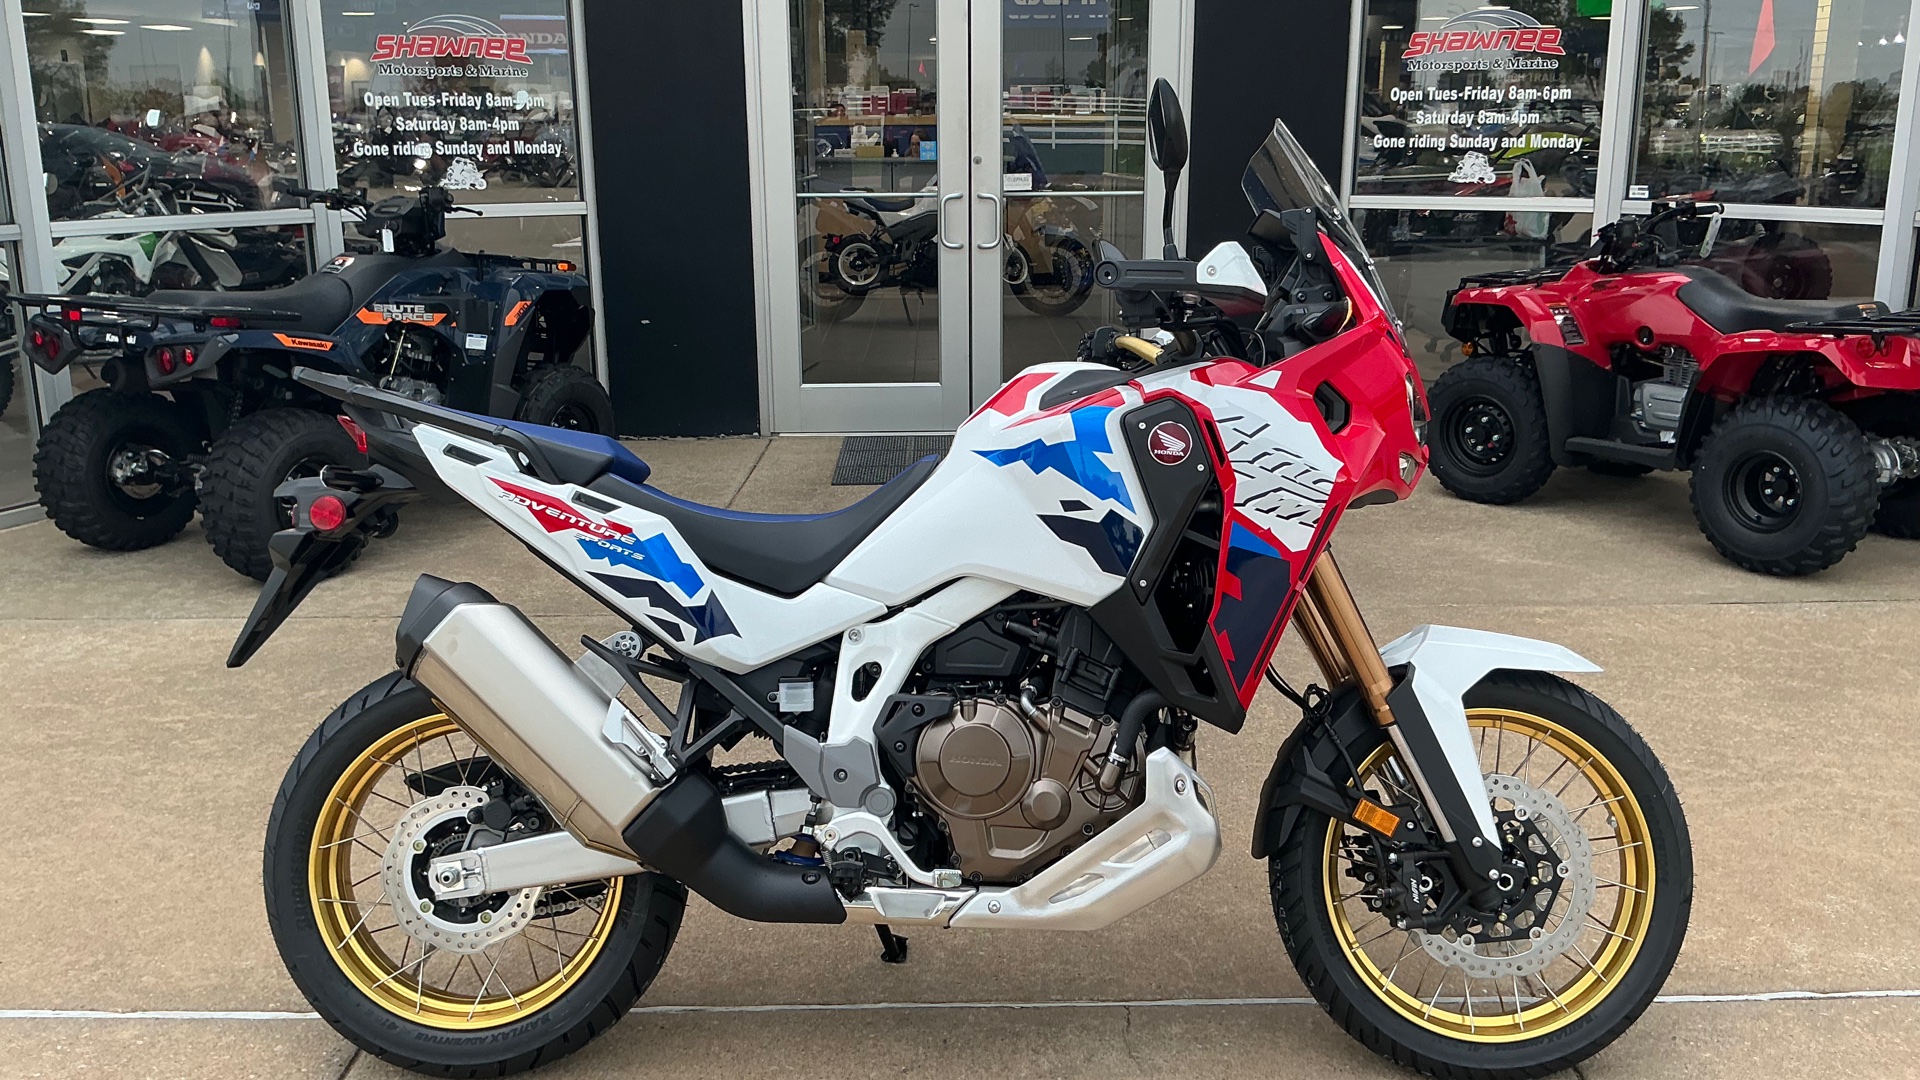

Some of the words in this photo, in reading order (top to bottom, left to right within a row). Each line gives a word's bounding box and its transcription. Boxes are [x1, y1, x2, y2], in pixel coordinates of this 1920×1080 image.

[378, 64, 462, 79] Motorsports
[465, 65, 477, 77] &
[479, 64, 528, 77] Marine
[1407, 59, 1489, 73] Motorsports
[1492, 59, 1504, 70] &
[1506, 57, 1558, 71] Marine
[364, 92, 400, 111] Open
[403, 91, 482, 110] Tues-Friday
[486, 91, 545, 110] 8am-pm
[1390, 87, 1423, 104] Open
[1427, 86, 1505, 104] Tues-Friday
[1508, 85, 1572, 103] 8am-6pm
[395, 116, 456, 134] Saturday
[459, 117, 520, 134] 8am-4pm
[1416, 110, 1474, 126] Saturday
[1478, 110, 1540, 126] 8am-4pm
[353, 141, 389, 157] Gone
[435, 140, 483, 160] Sunday
[487, 141, 509, 155] and
[514, 140, 562, 158] Monday
[1373, 135, 1405, 149] Gone
[1409, 134, 1446, 151] riding
[1450, 134, 1499, 151] Sunday
[1501, 134, 1526, 149] and
[1530, 133, 1583, 151] Monday
[373, 303, 425, 313] BRUTE
[513, 302, 529, 319] 300
[383, 312, 434, 321] FORCE
[291, 338, 328, 349] Kawasaki
[1153, 449, 1185, 457] HONDA
[499, 491, 637, 546] ADVENTURE
[574, 532, 646, 562] SPORTS
[949, 755, 1003, 767] HONDA
